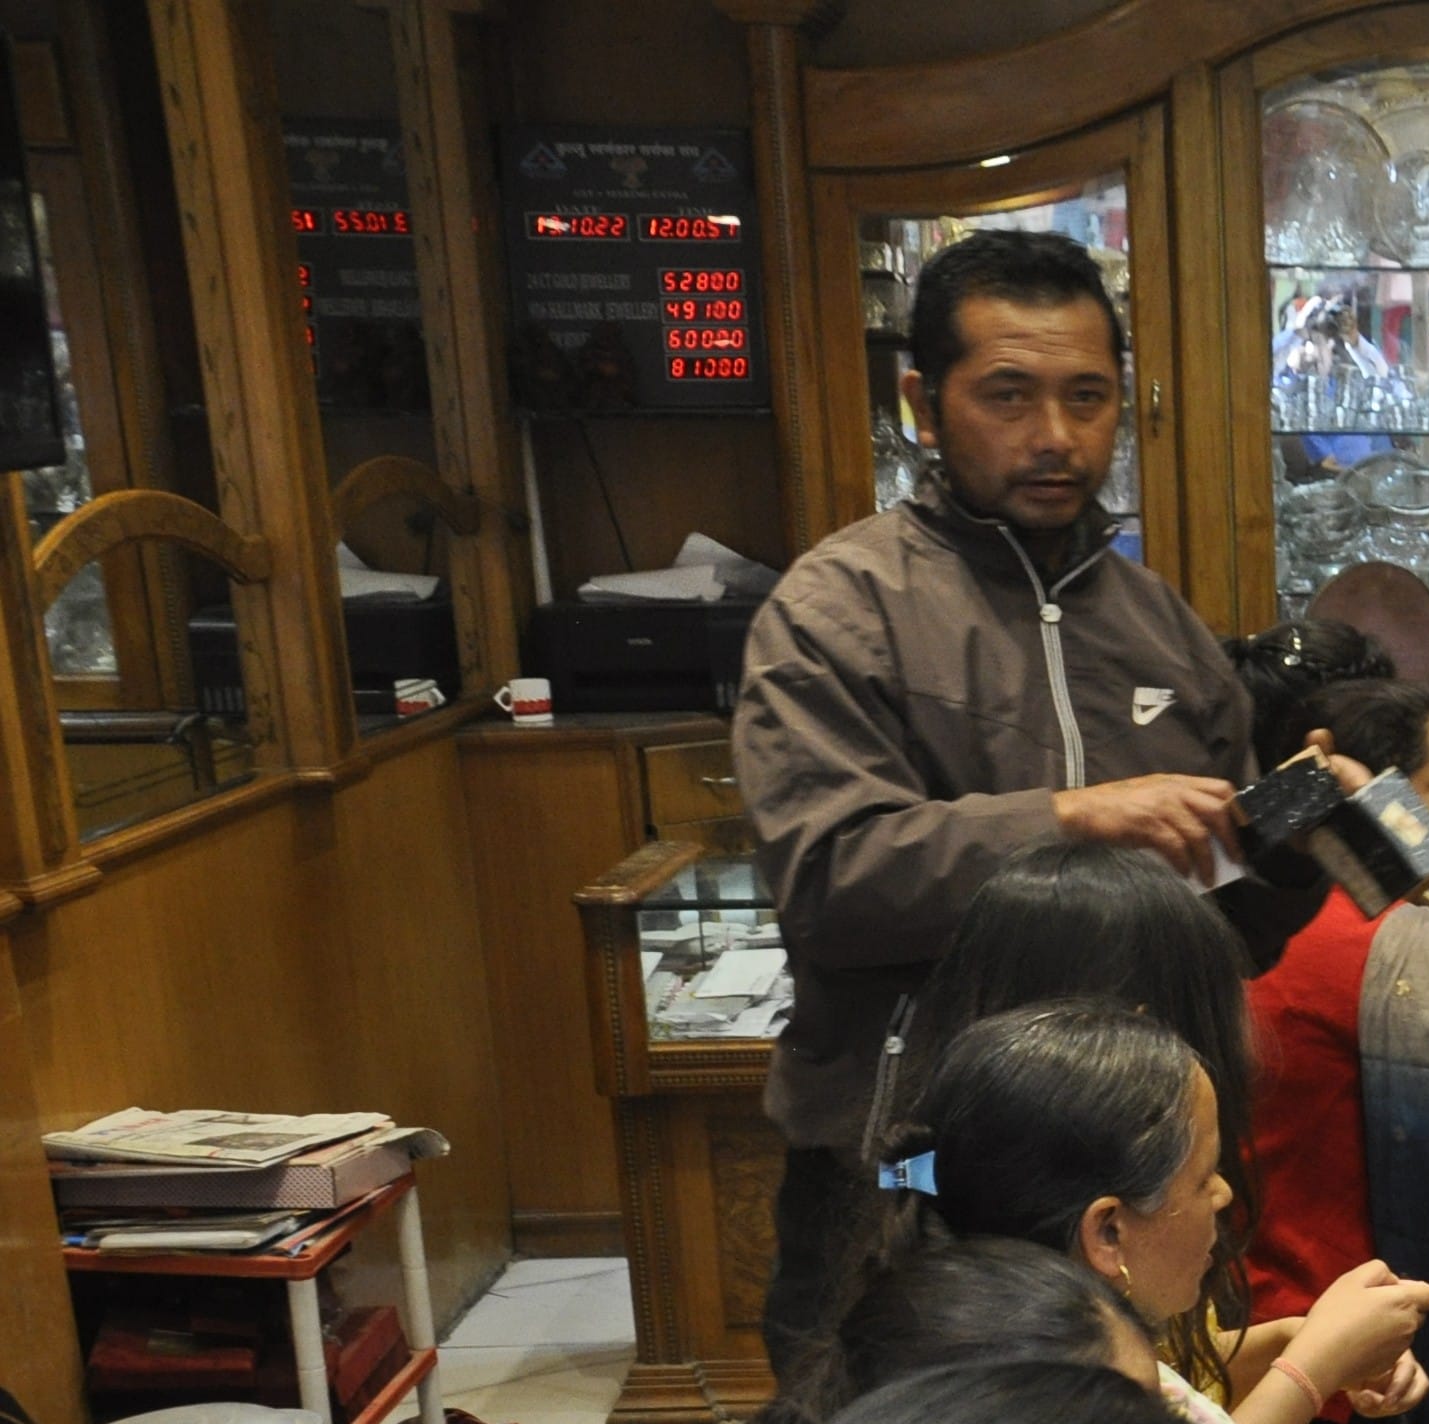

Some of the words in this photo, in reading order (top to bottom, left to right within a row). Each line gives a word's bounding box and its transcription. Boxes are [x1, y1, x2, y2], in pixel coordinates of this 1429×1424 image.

[662, 270, 740, 292] 52800
[665, 299, 743, 321] 49100
[668, 328, 745, 350] 60000
[671, 356, 748, 379] 81000
